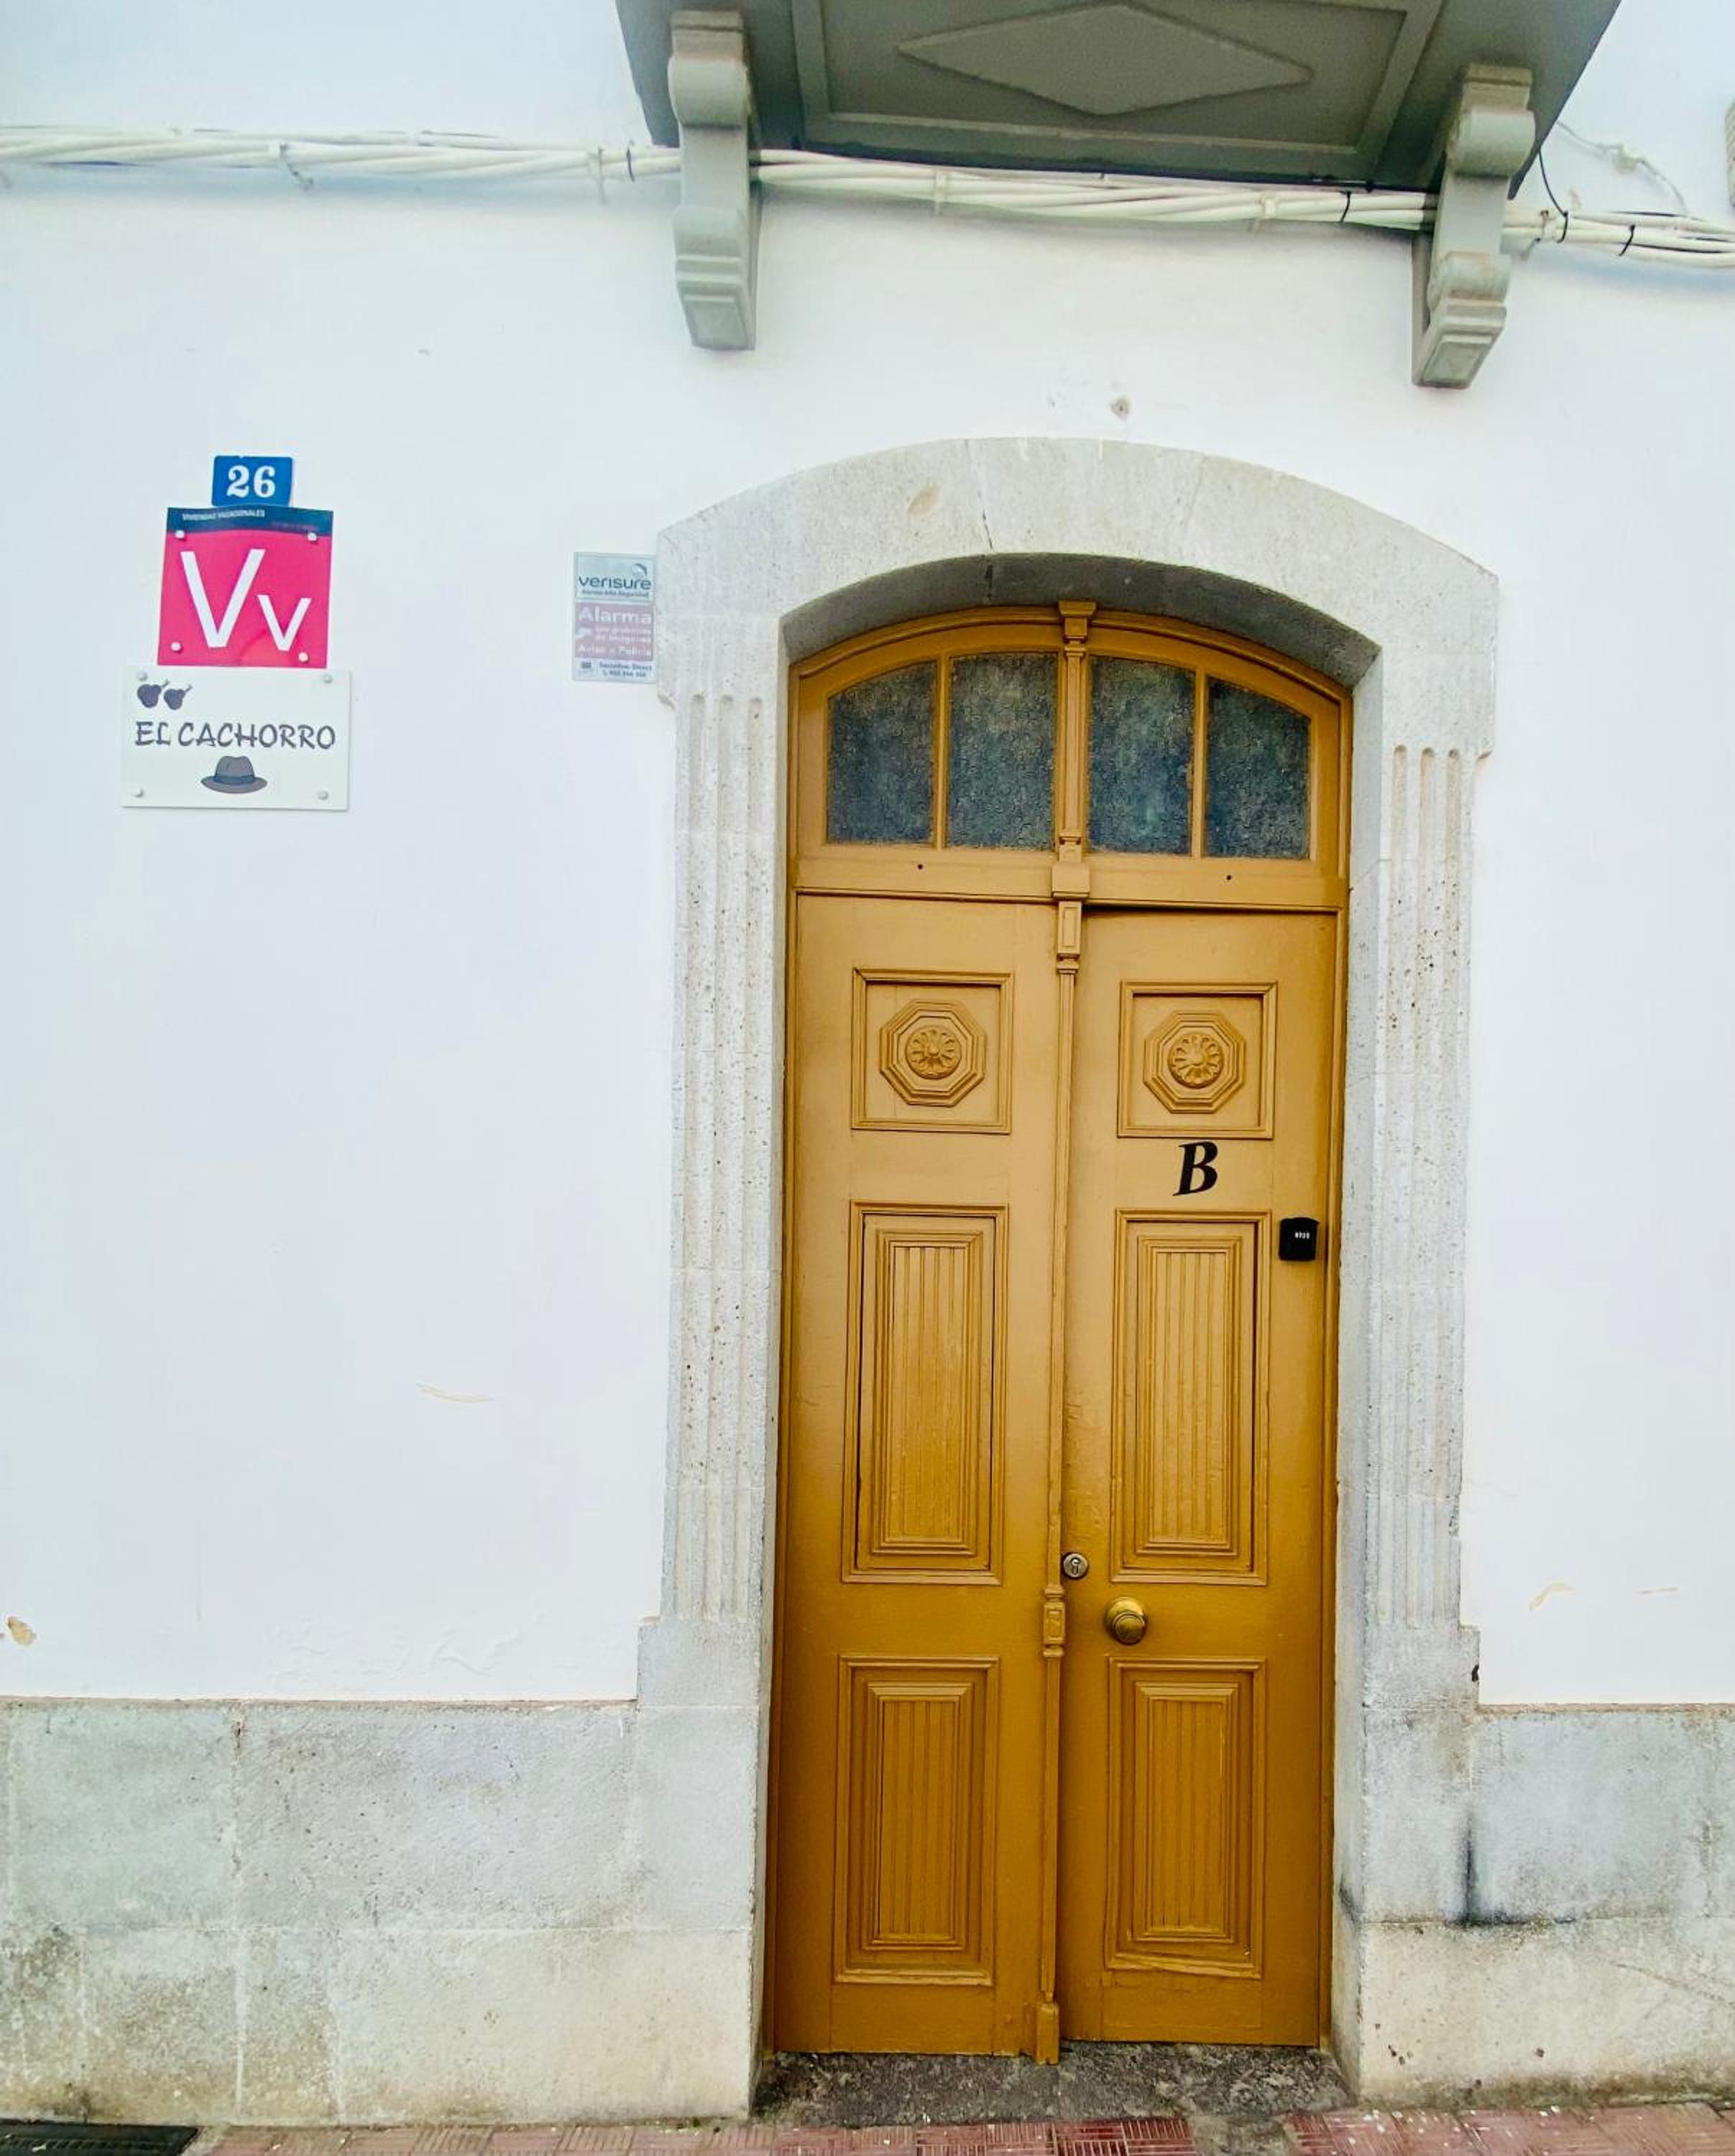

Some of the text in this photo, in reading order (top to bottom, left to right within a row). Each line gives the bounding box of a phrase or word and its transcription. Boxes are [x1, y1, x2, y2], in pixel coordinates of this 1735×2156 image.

[226, 464, 277, 499] 26
[579, 576, 652, 590] verisure
[578, 606, 652, 624] Alarma
[134, 721, 336, 750] EL CACHORRO
[1172, 1141, 1218, 1197] B
